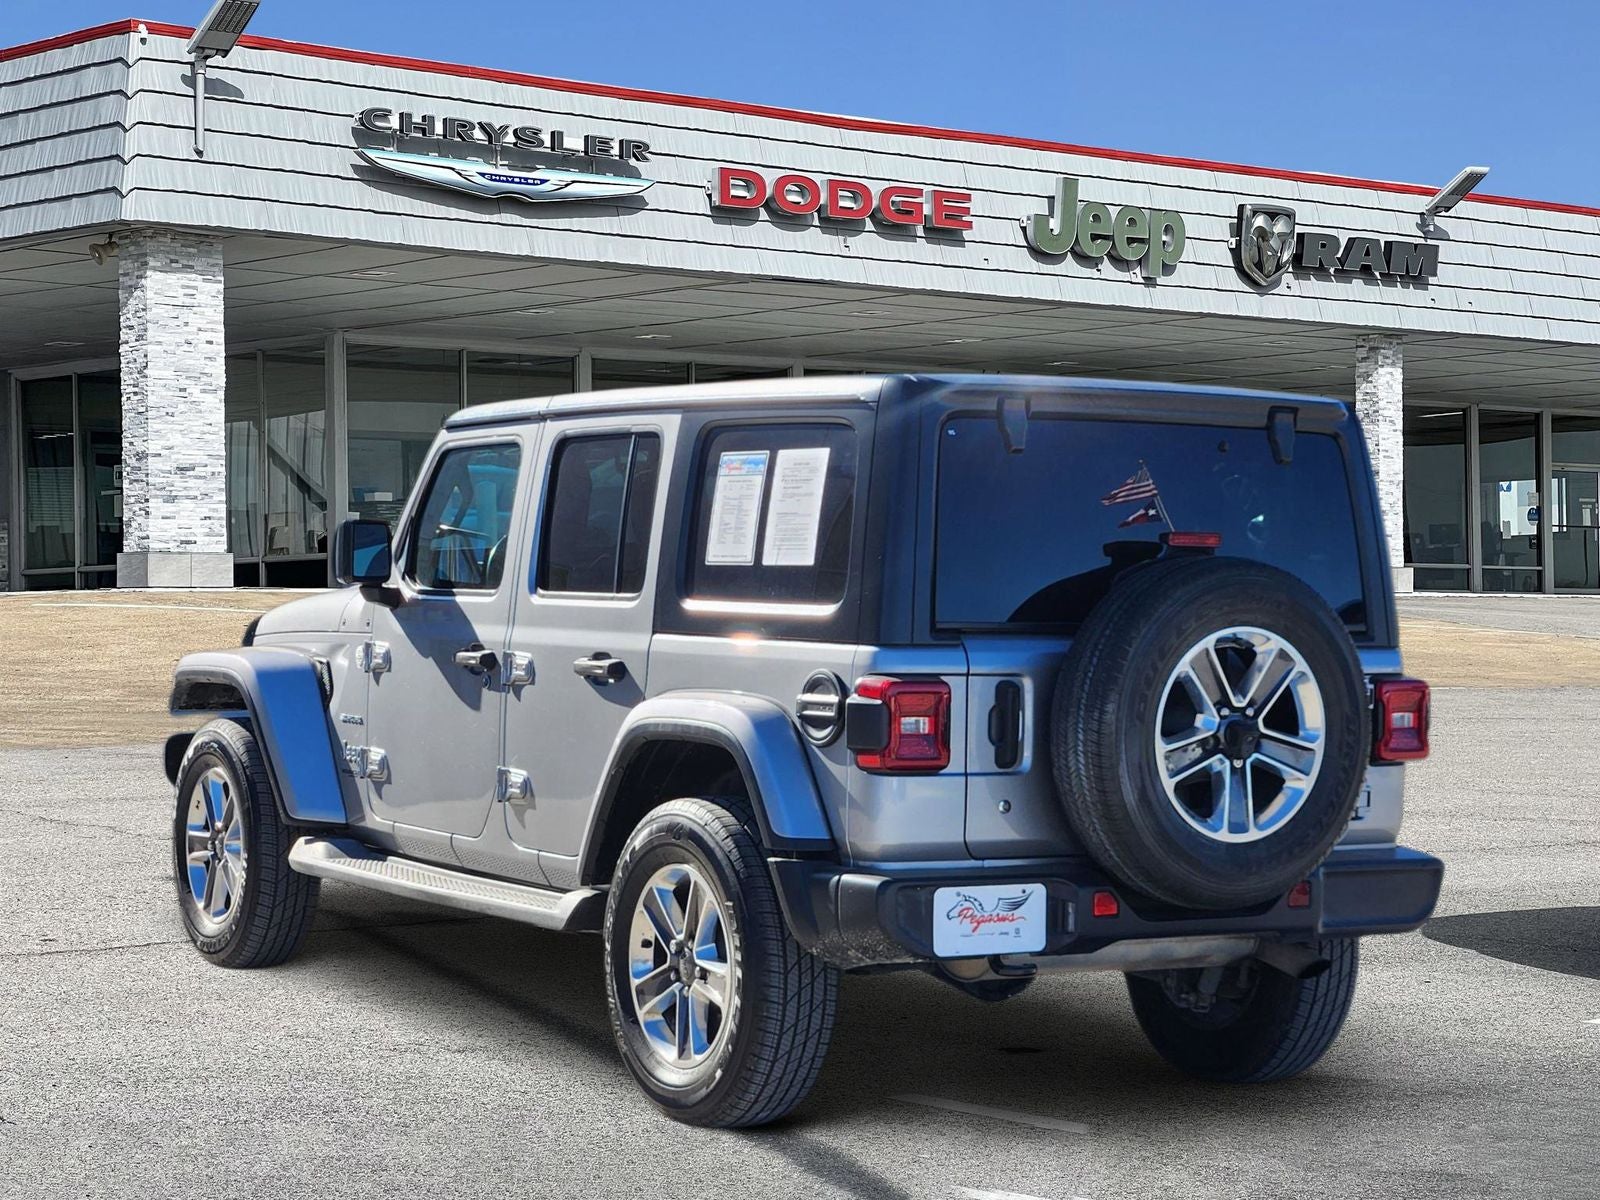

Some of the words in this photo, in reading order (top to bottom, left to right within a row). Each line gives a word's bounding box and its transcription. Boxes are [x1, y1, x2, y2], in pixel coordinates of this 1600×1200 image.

[357, 106, 650, 163] CHRYSLER
[483, 173, 543, 186] CHRYSLER
[712, 166, 974, 231] DODGE
[1026, 176, 1187, 279] Jeep
[1298, 231, 1440, 277] RAM
[958, 906, 1027, 933] Pegasus
